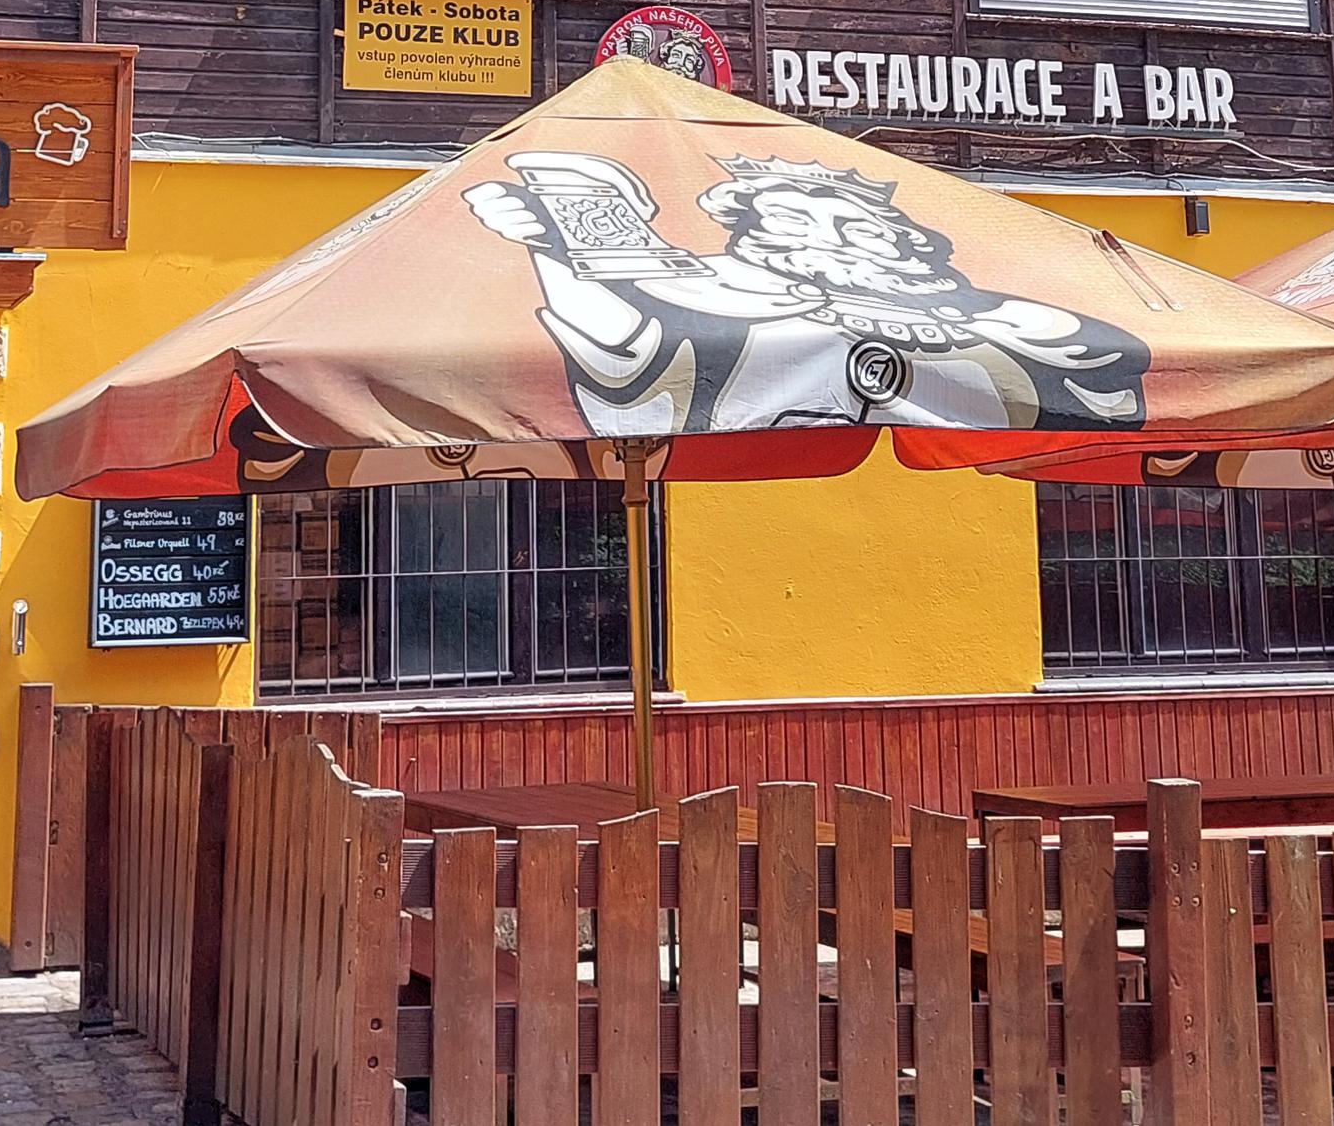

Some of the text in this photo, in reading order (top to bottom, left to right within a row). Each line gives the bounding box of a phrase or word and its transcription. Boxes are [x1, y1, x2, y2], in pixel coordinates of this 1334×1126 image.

[444, 2, 520, 22] Sobota
[358, 22, 520, 47] POUZE KLUB
[601, 10, 726, 67] PATRON NAŠEHO PIVA
[358, 50, 521, 68] vstup povolen výhradně
[384, 67, 494, 84] členům klubu !!!
[771, 48, 1238, 124] RESTAURACE A BAR
[123, 507, 173, 519] Gambrinus
[123, 538, 155, 549] Pilsner
[158, 538, 190, 552] Urquell
[196, 534, 217, 552] 49
[98, 613, 178, 636] BERNARD
